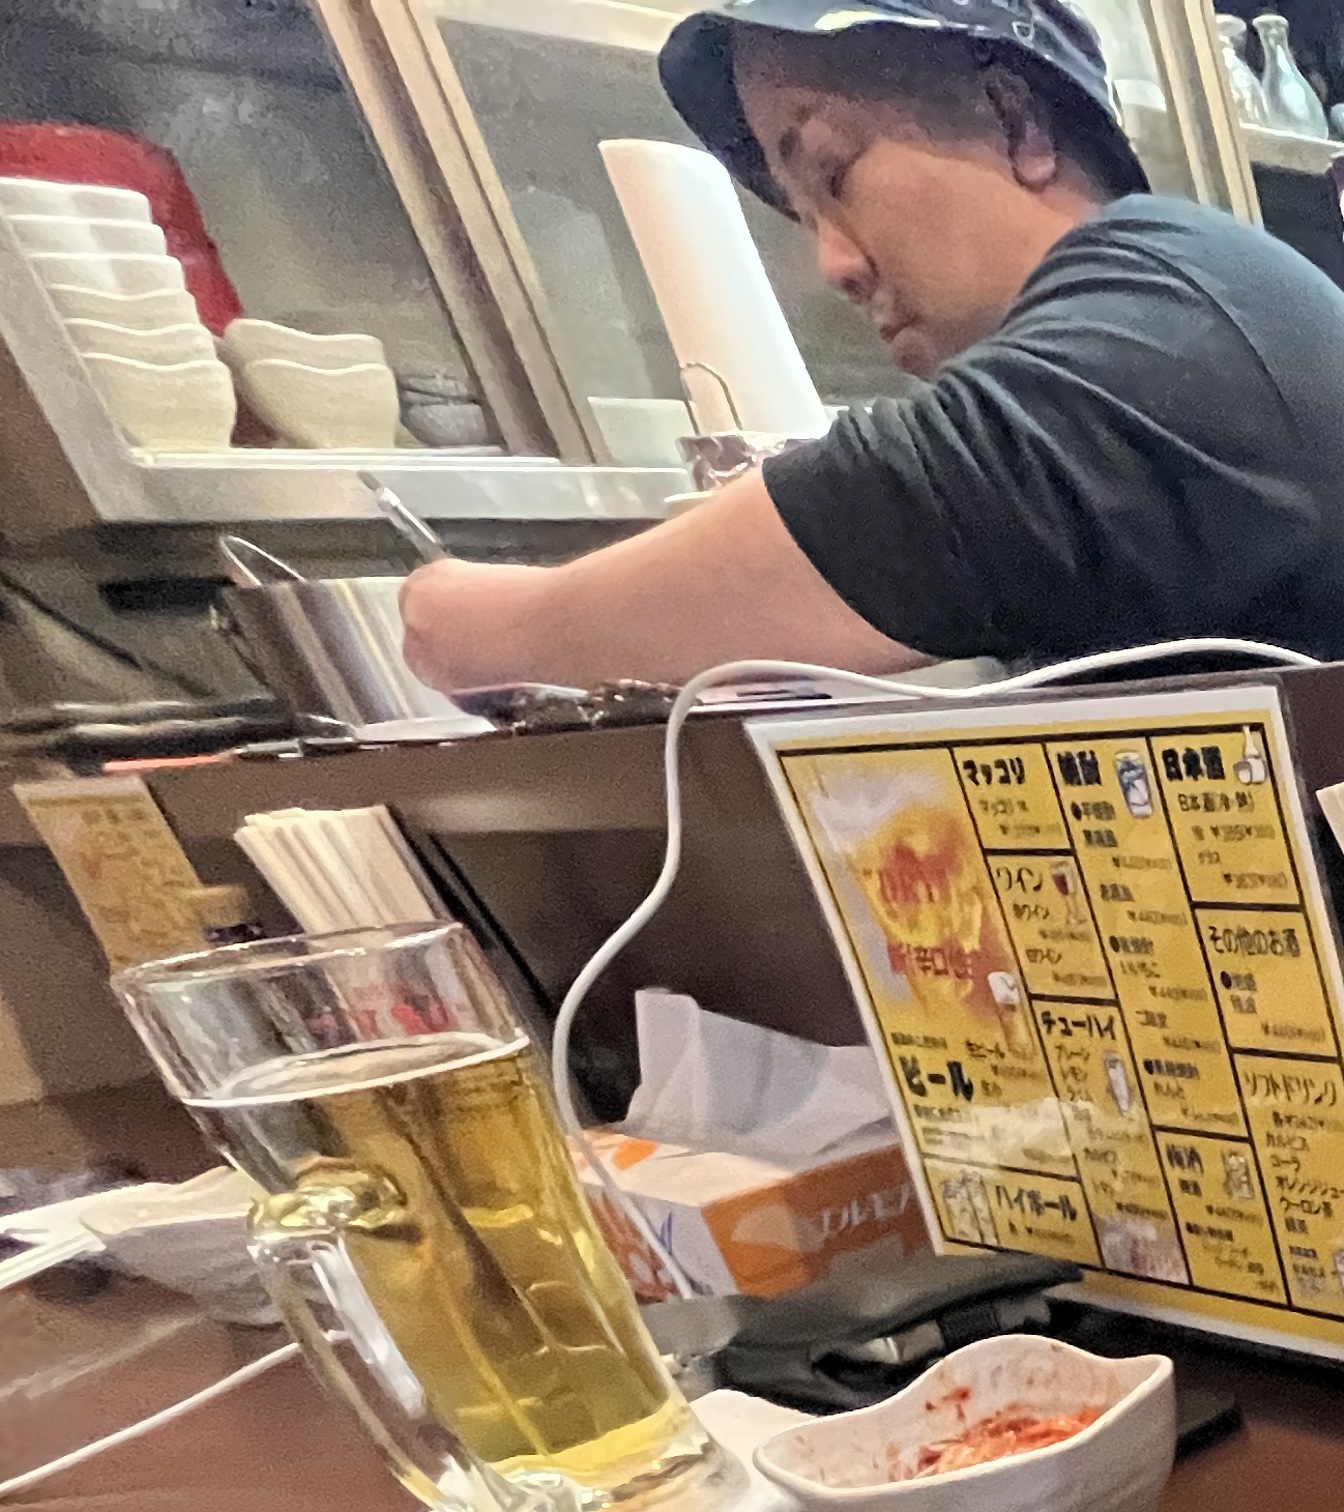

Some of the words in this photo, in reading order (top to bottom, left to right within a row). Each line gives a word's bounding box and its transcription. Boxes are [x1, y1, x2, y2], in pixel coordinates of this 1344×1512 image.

[963, 756, 1026, 785] マッコリ
[996, 866, 1044, 894] ワイン
[1041, 1010, 1116, 1041] チューハイ
[899, 1056, 975, 1102] ビール
[1243, 1070, 1338, 1107] ソフトドリンク
[996, 1185, 1078, 1222] ハイボール
